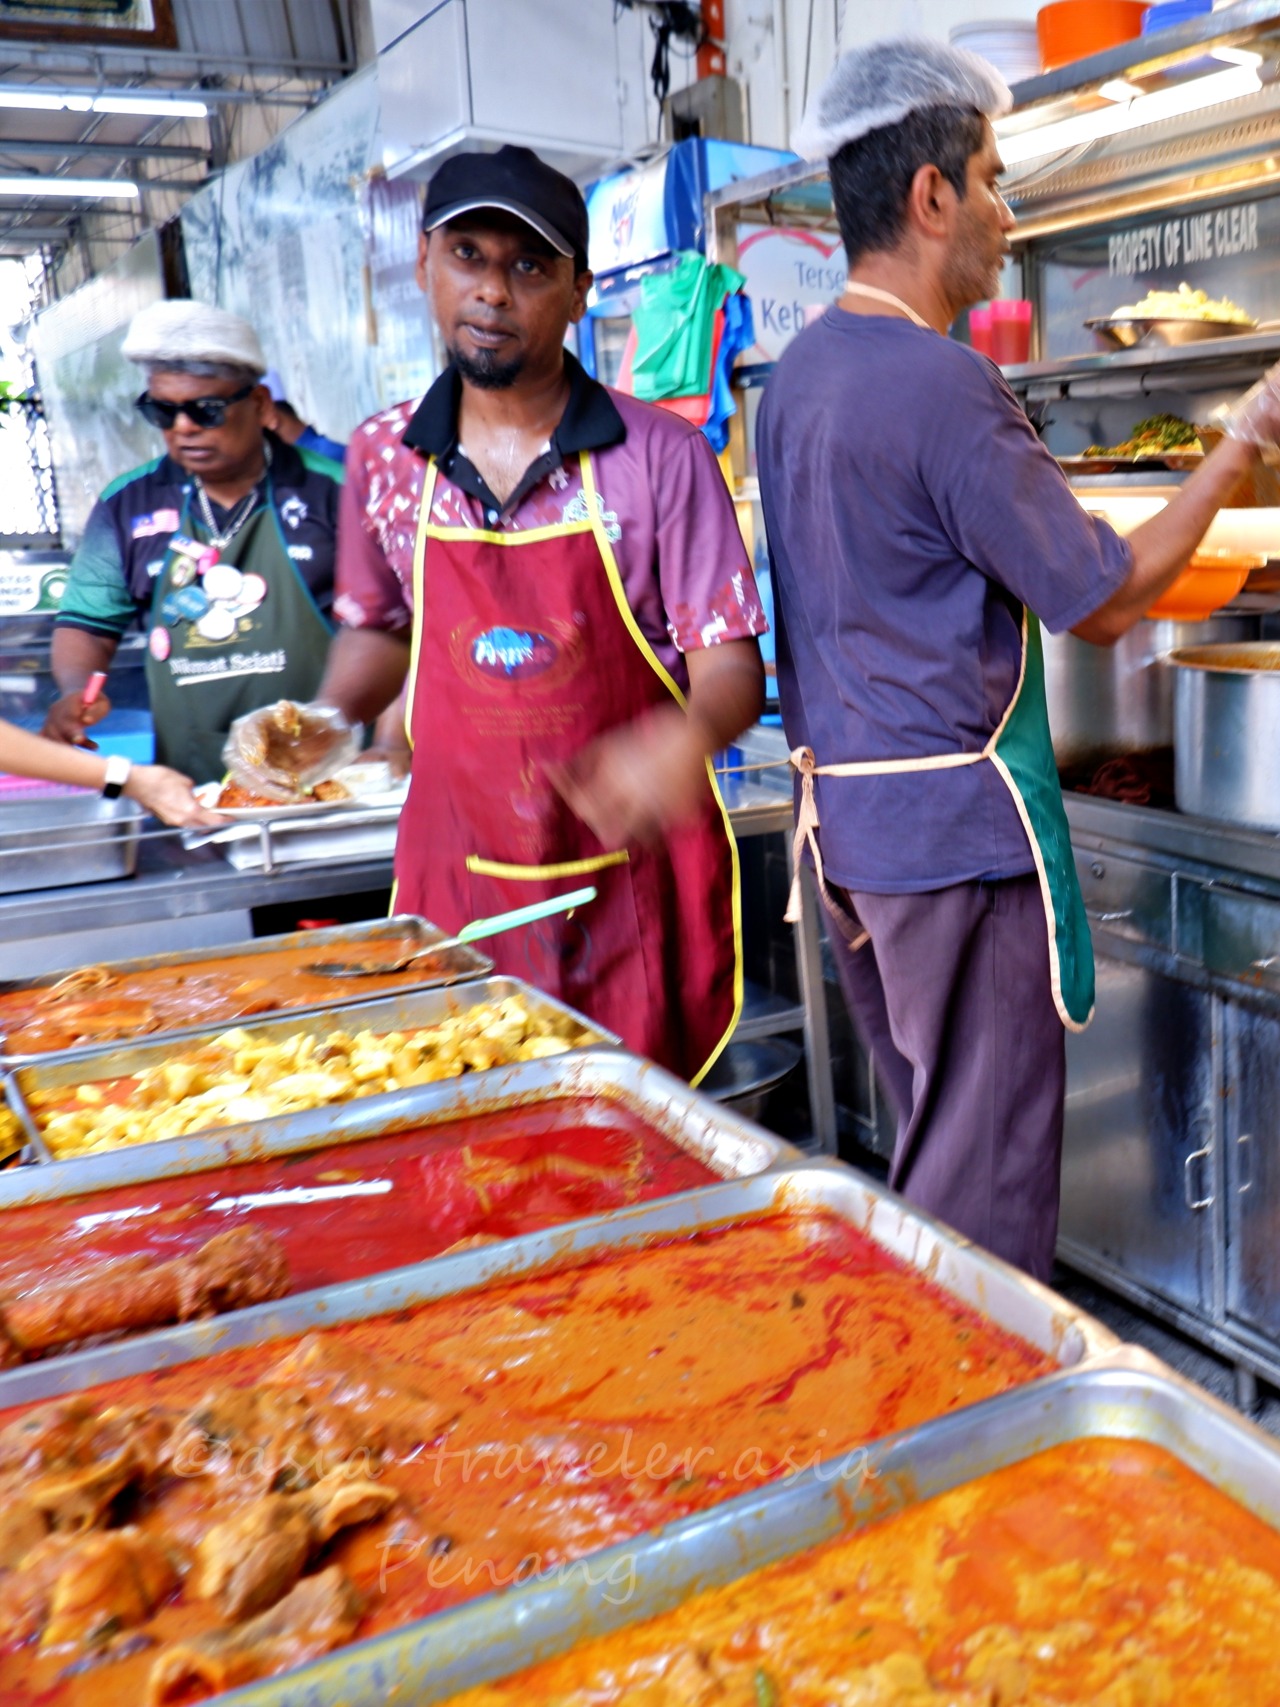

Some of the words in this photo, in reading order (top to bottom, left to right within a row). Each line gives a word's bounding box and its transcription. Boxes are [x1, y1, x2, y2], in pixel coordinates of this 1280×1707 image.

[1164, 218, 1181, 268] OF
[1183, 211, 1213, 264] LINE
[1215, 203, 1259, 258] CLEAR
